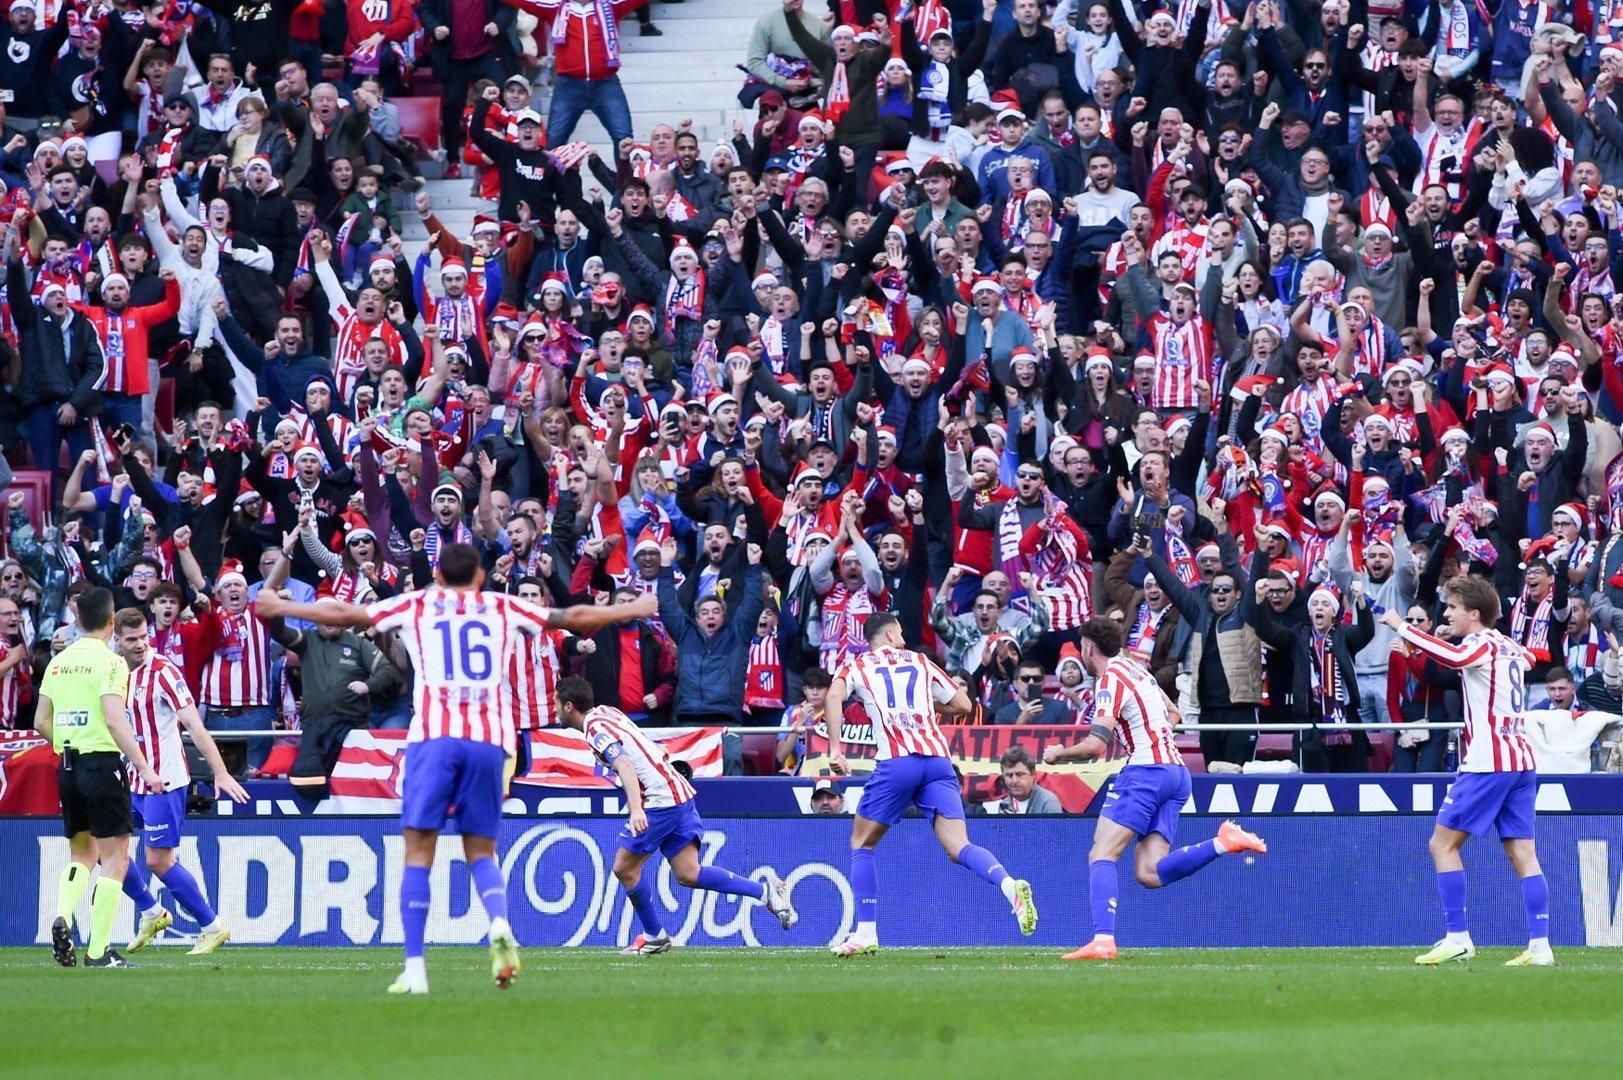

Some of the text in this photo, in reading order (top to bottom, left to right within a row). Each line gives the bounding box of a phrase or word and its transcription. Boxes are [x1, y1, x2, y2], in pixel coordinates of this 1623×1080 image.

[433, 620, 493, 681] 16
[875, 665, 919, 709] 17
[1508, 660, 1523, 713] 8
[56, 710, 89, 727] BKT
